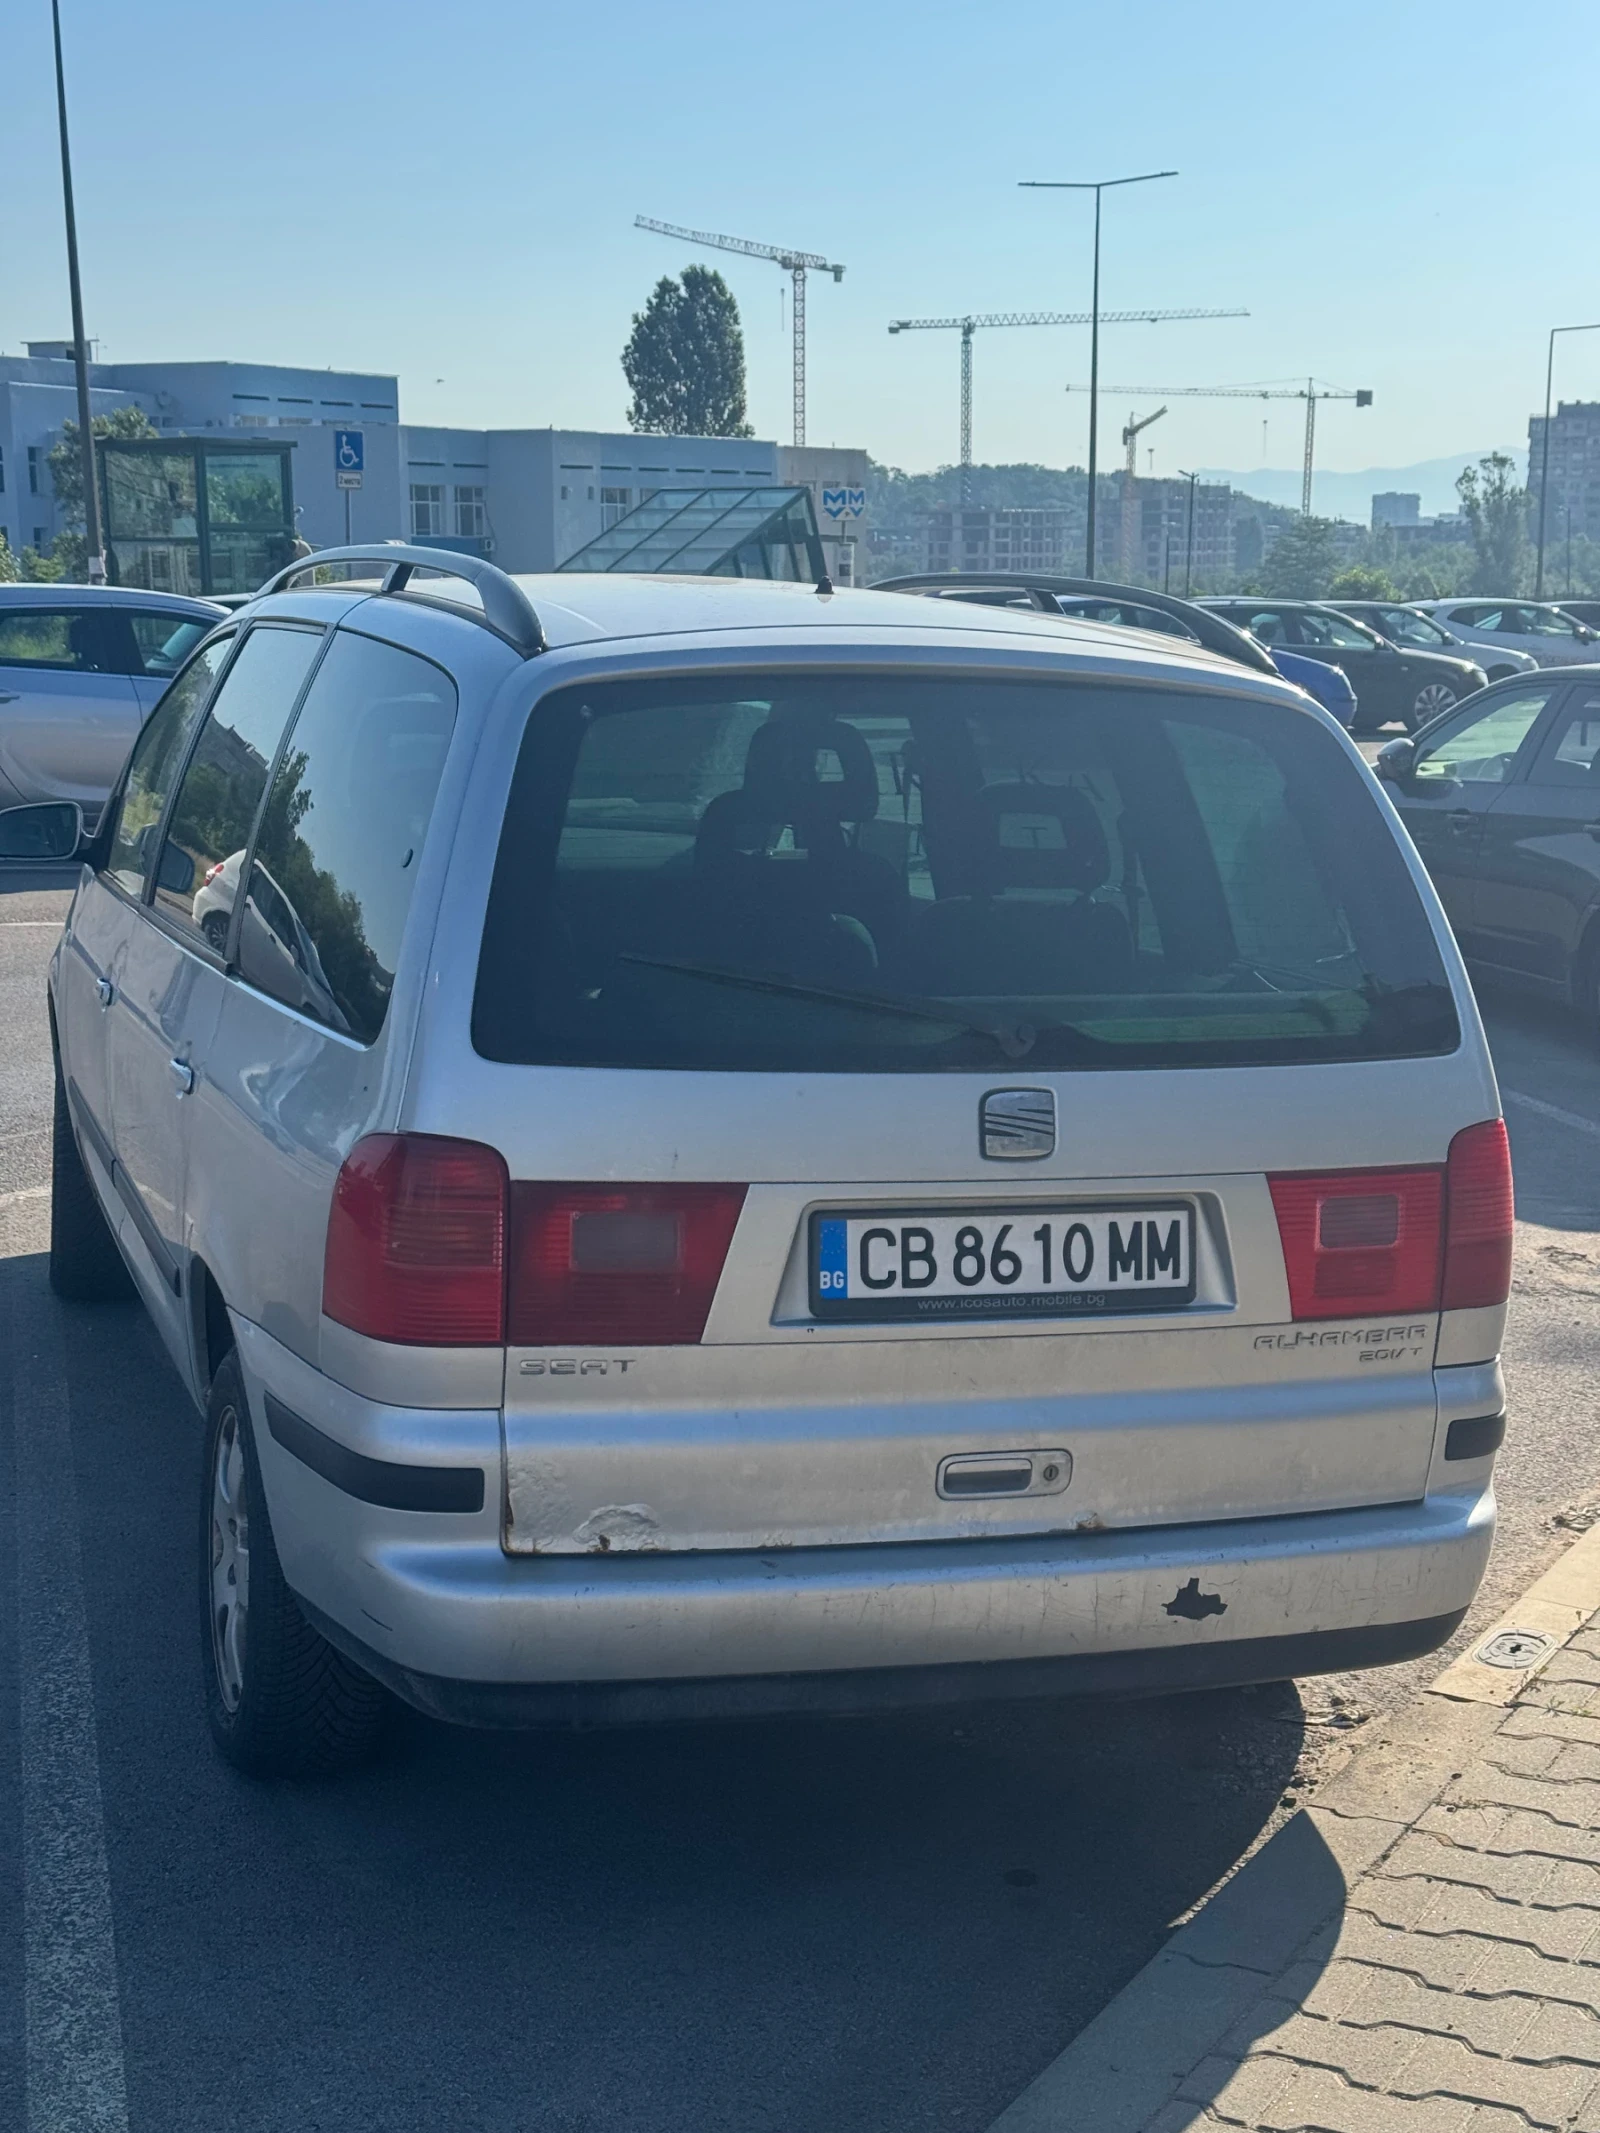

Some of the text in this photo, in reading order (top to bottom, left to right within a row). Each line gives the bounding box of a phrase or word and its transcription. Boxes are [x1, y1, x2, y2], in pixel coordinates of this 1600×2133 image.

[860, 1219, 1181, 1290] CB 8610 MM
[819, 1270, 845, 1290] BG
[917, 1294, 1106, 1310] www.icosauto.mobile.bg
[1254, 1325, 1428, 1350] ALHAMBRA
[520, 1358, 637, 1375] SEAT
